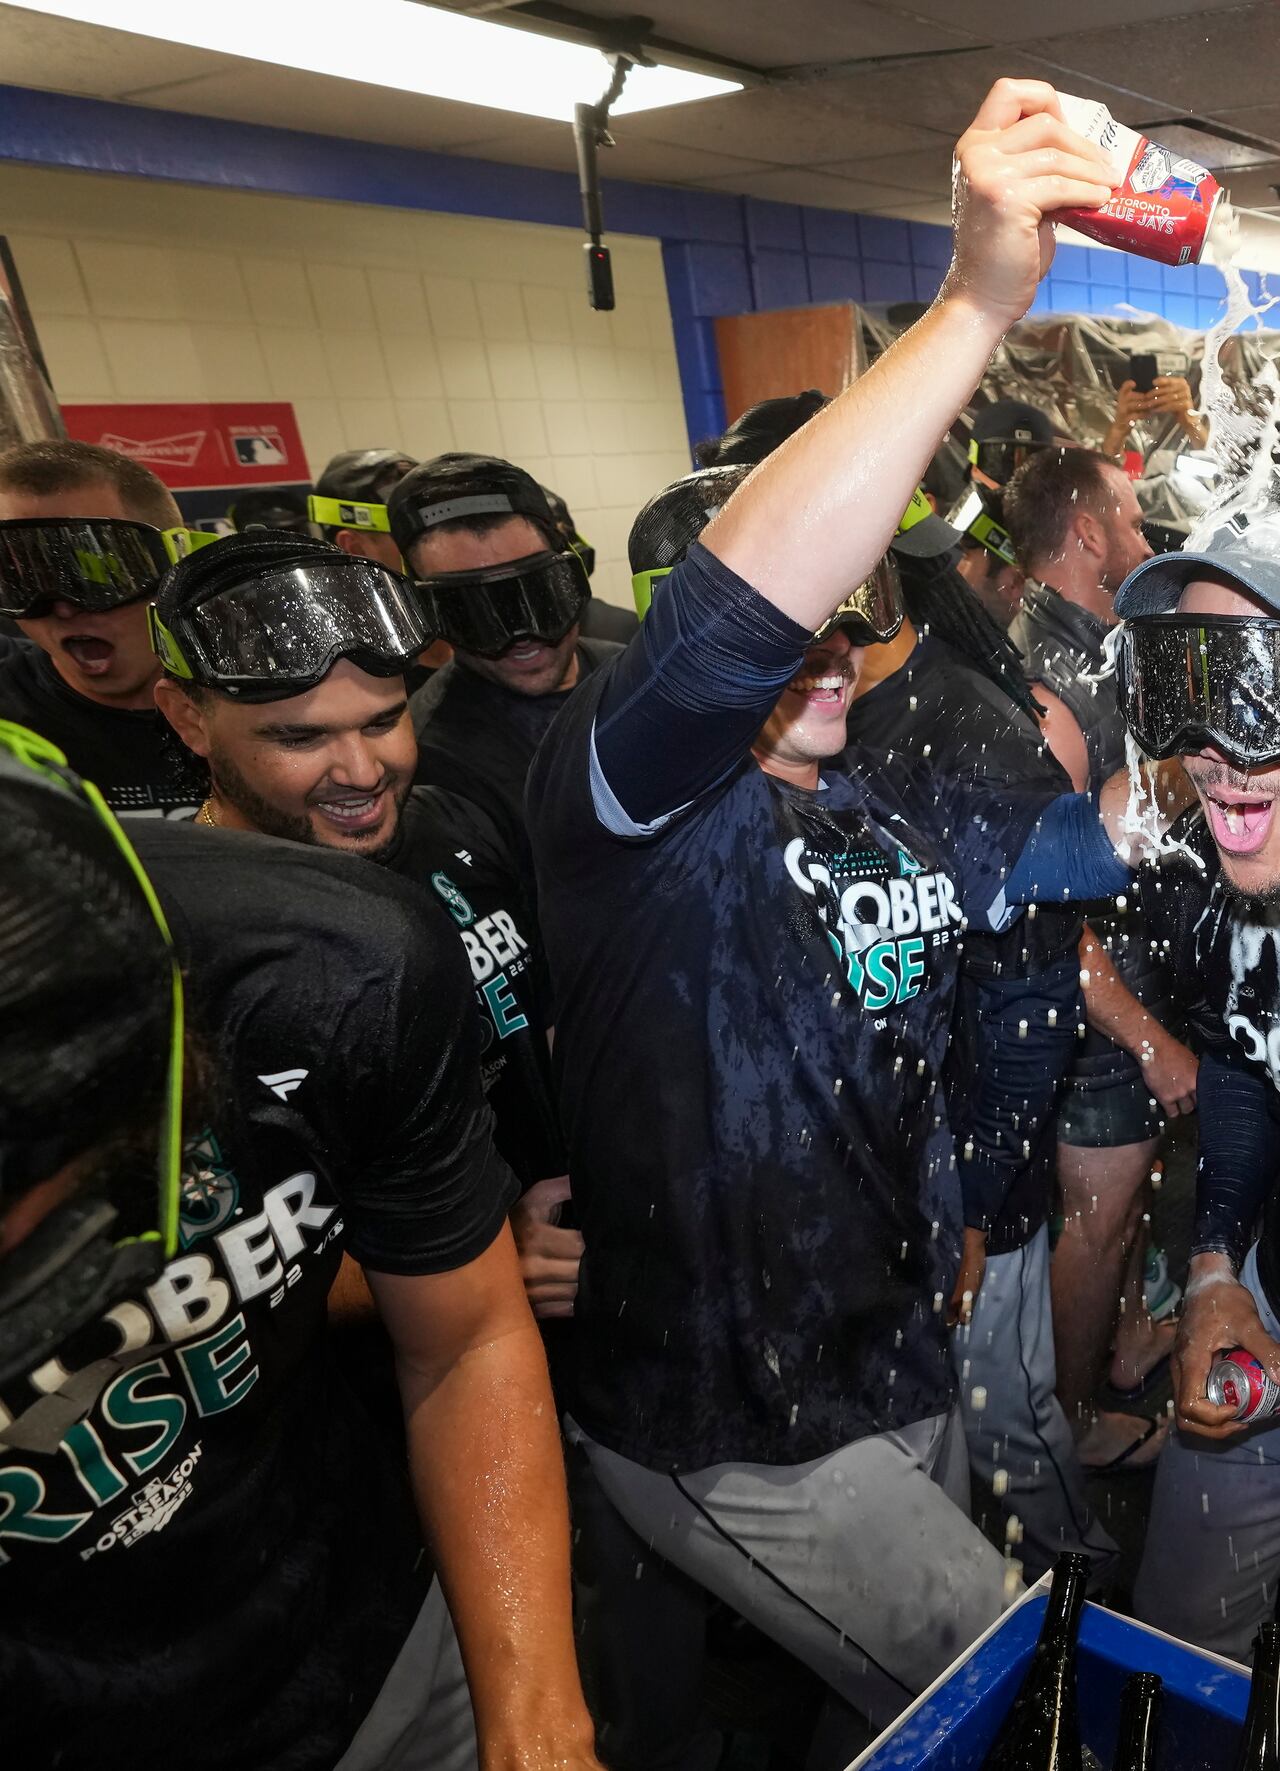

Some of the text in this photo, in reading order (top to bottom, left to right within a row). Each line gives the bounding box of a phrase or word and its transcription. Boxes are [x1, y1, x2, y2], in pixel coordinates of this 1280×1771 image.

[1098, 203, 1175, 235] BLUE JAYS
[1119, 197, 1170, 217] TORONTO
[80, 1440, 203, 1561] POSTSEASON
